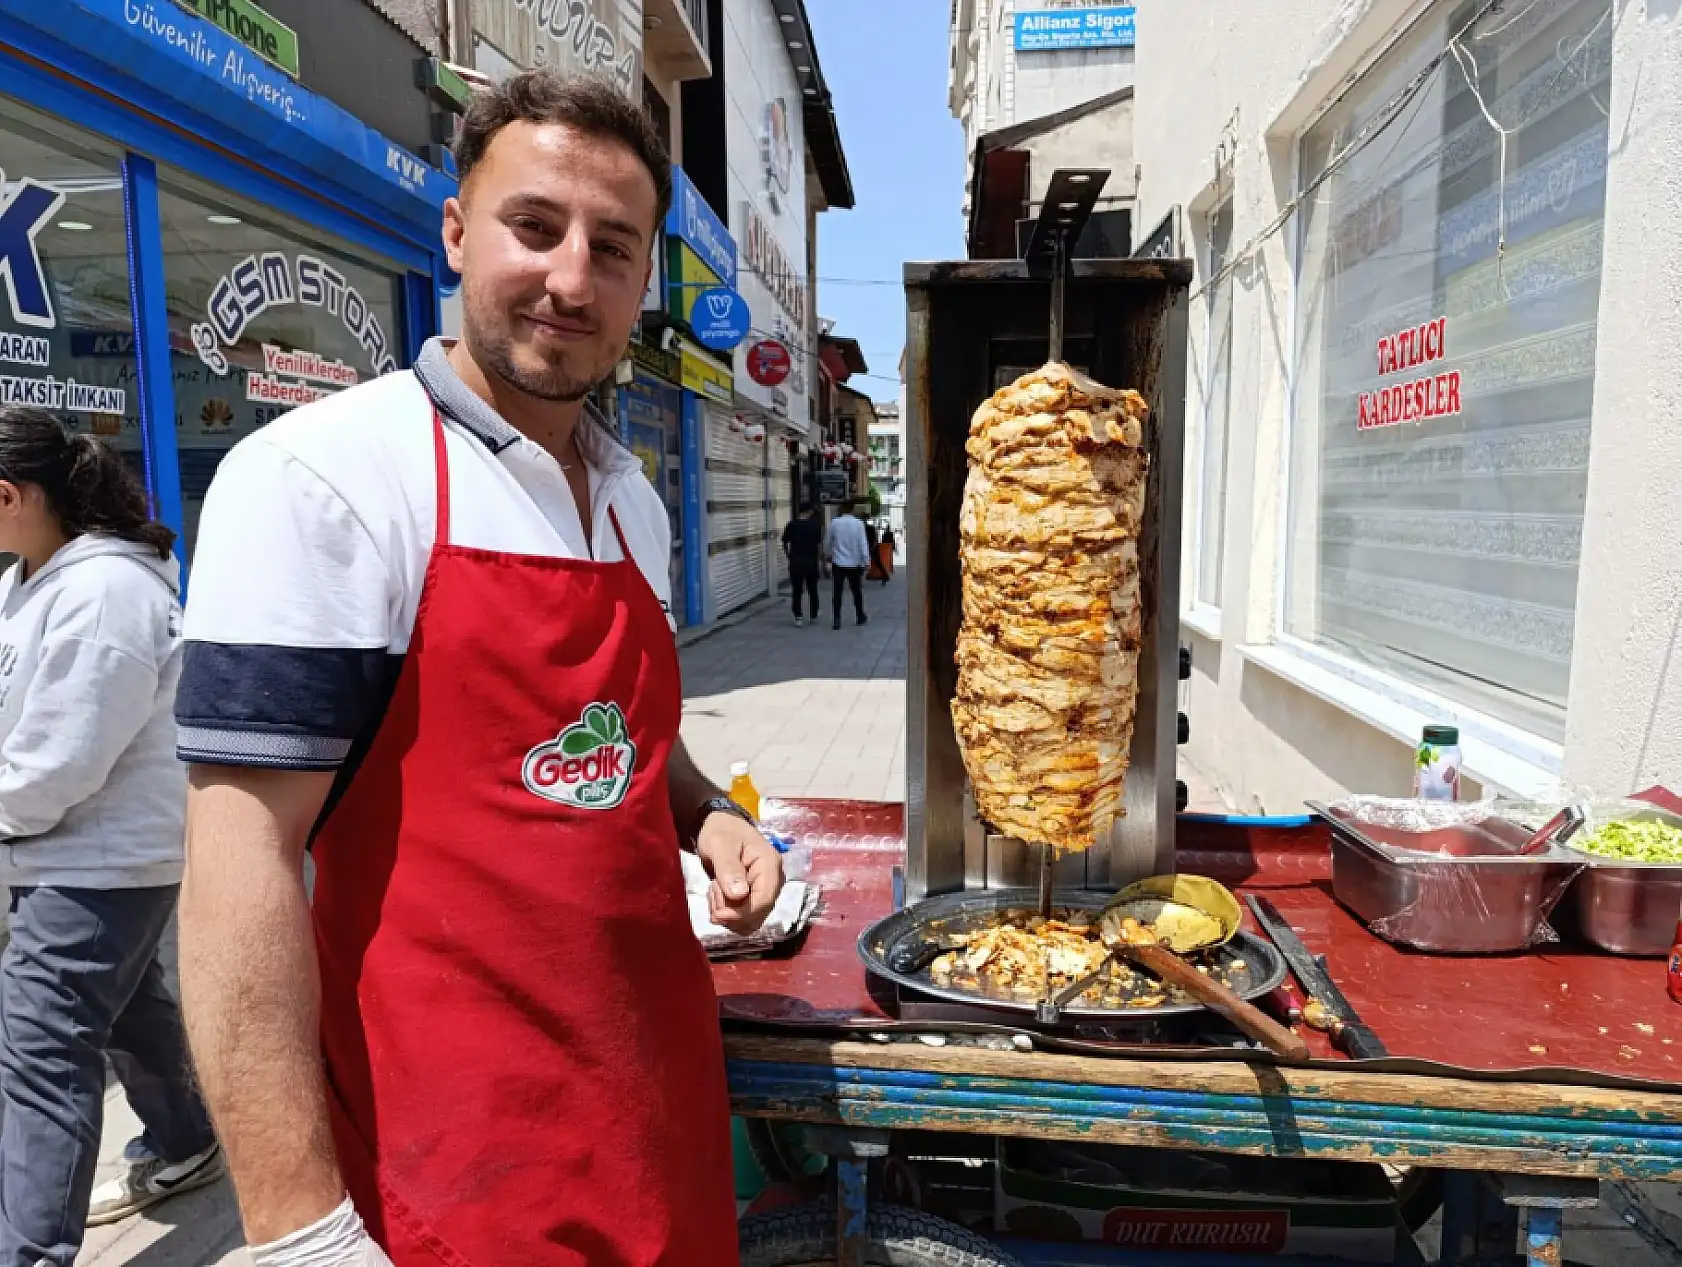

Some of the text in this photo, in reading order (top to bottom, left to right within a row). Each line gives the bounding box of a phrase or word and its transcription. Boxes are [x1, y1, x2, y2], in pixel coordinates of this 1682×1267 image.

[125, 0, 216, 67] Güvenilir
[1022, 12, 1135, 31] Allianz Sigor
[208, 252, 296, 346] GSM
[262, 343, 359, 385] Yeniliklerden
[1377, 316, 1447, 376] TATLICI
[2, 374, 126, 415] TAKSİT İMKANI
[247, 372, 320, 404] Haberdar
[1356, 370, 1463, 431] KARDEŞLER
[533, 744, 626, 787] Gedik
[1116, 1221, 1271, 1245] DUT KURUSU
